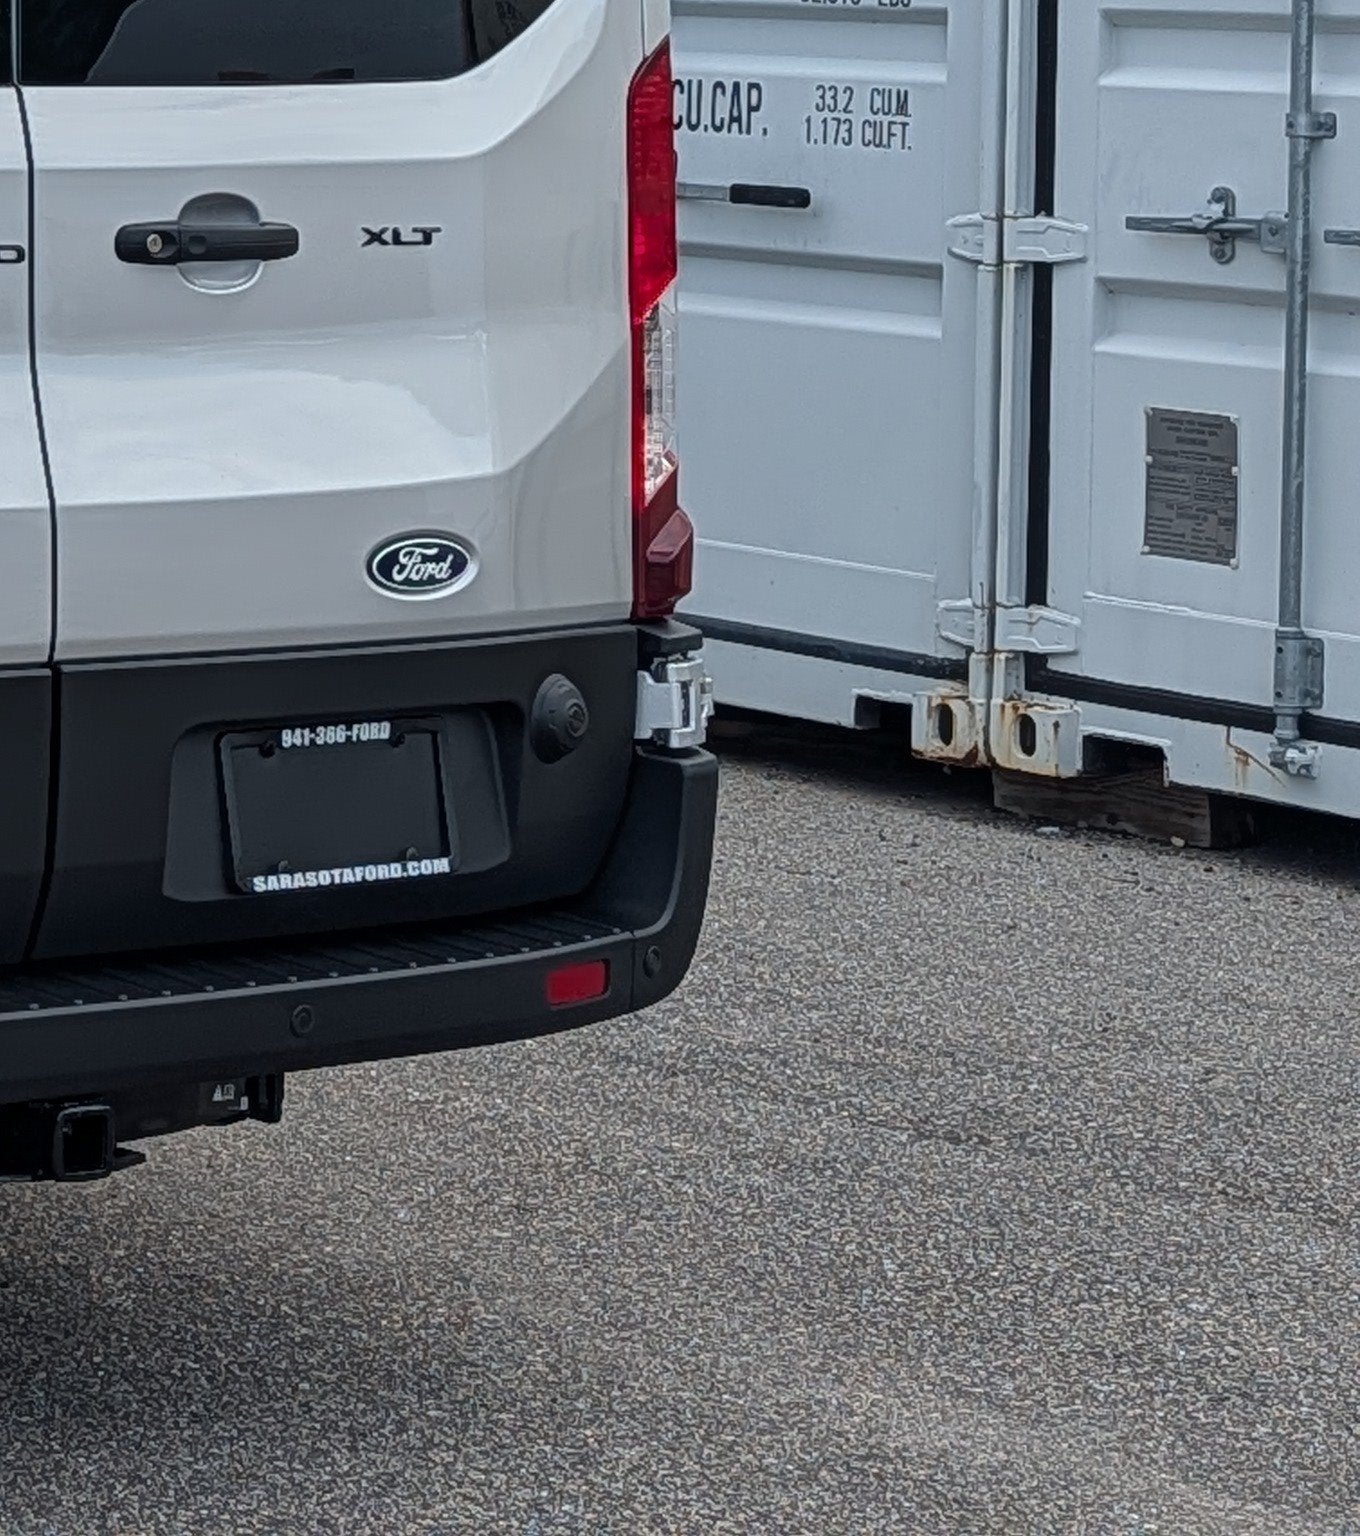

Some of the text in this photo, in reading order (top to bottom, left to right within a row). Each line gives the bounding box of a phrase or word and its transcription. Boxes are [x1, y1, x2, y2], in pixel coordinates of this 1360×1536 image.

[671, 78, 769, 136] CU.CAP.
[814, 84, 855, 114] 33.2
[804, 115, 853, 147] 1.173
[360, 226, 442, 248] XLT
[391, 546, 454, 582] Ford
[252, 857, 451, 893] SARASOTAFORD.COM
